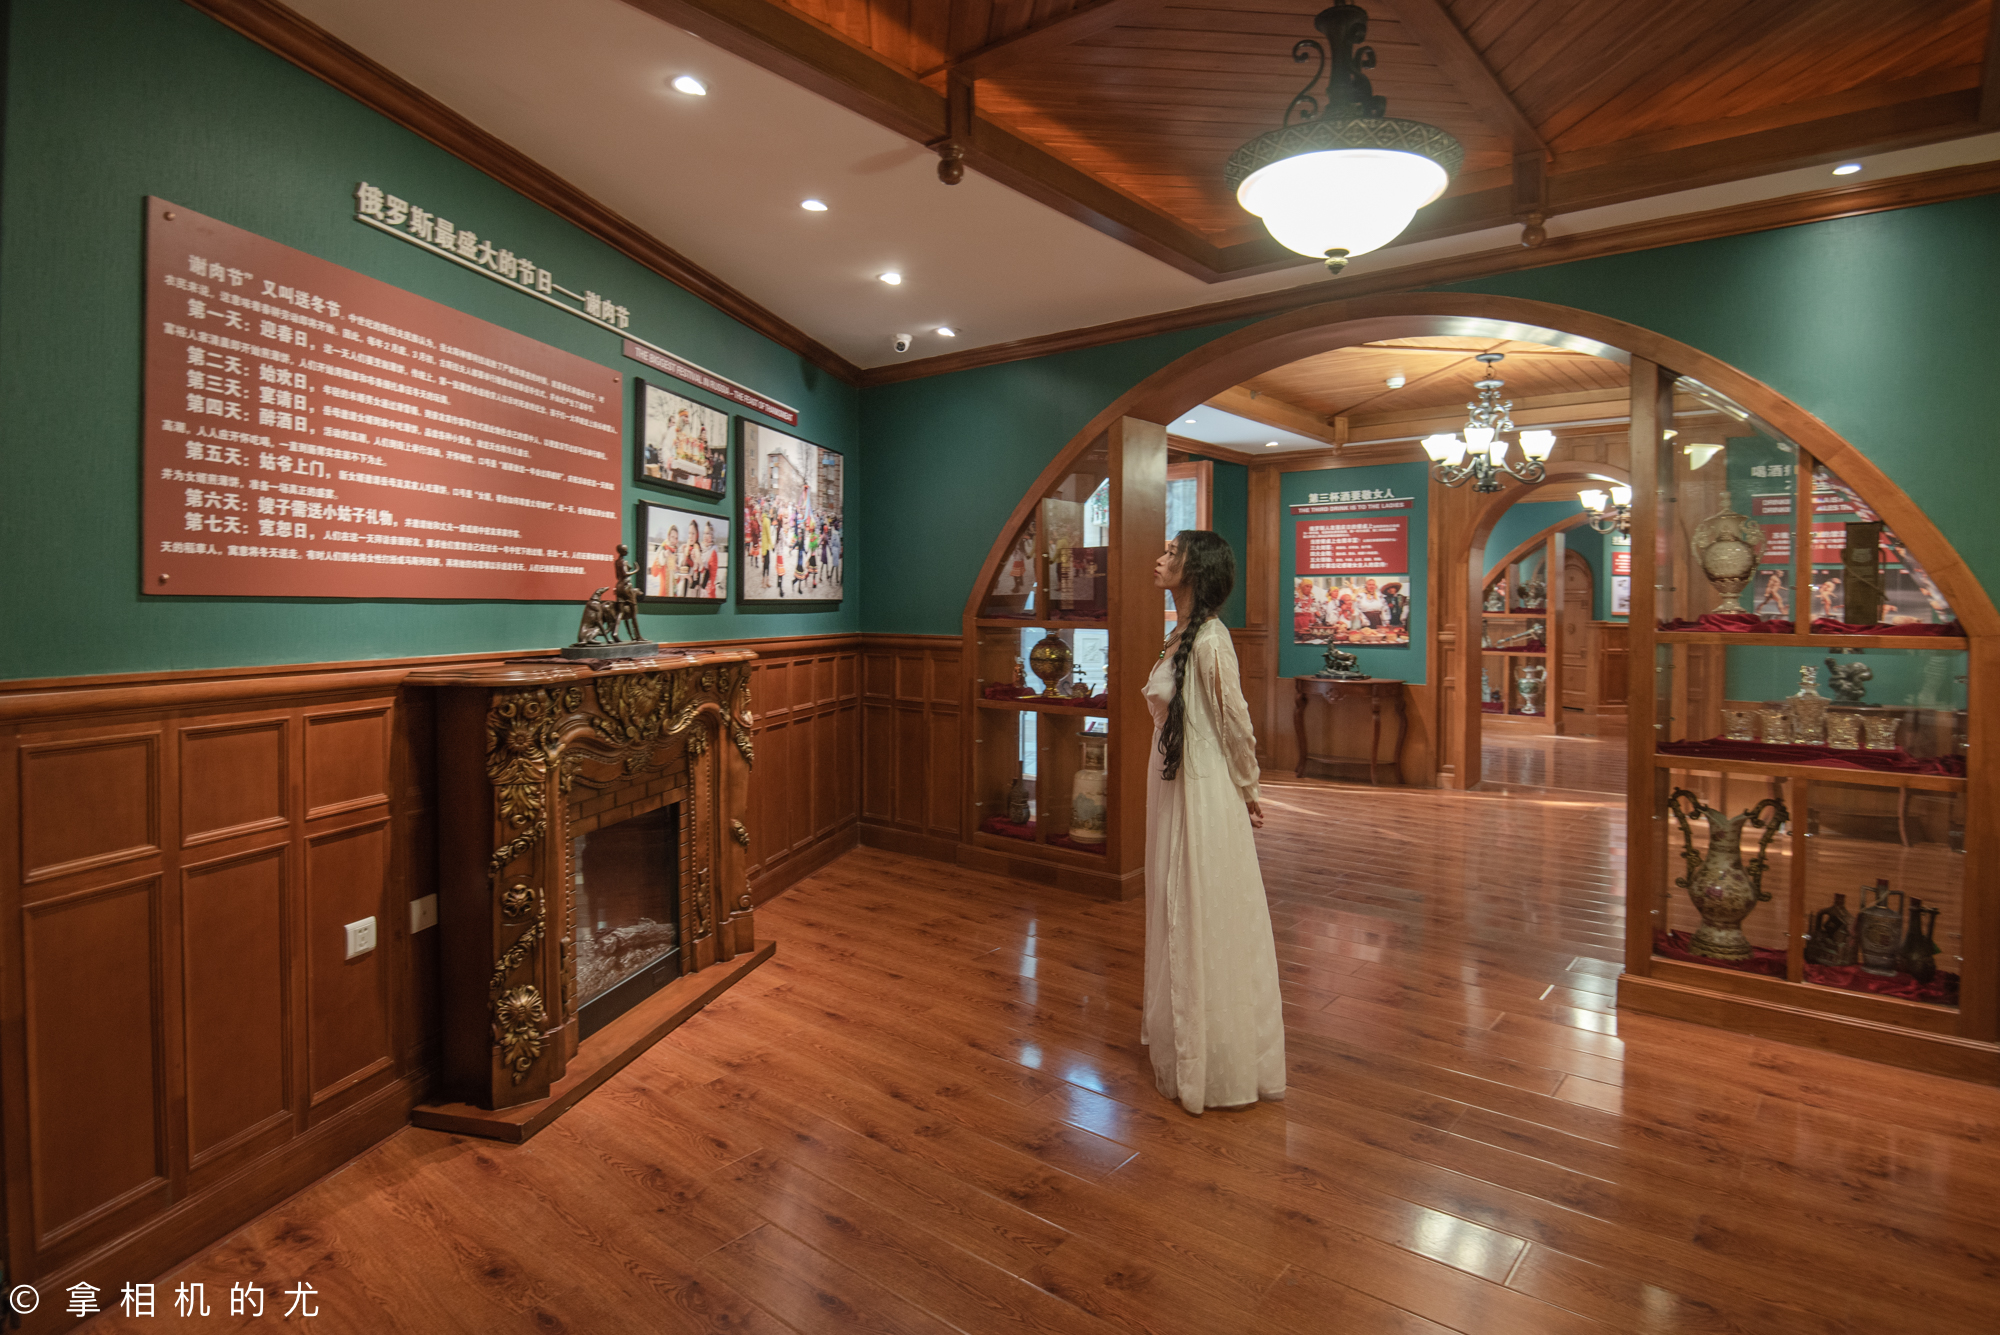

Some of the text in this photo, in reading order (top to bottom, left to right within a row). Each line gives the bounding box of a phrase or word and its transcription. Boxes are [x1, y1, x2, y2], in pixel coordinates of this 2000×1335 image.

[635, 347, 649, 361] THE
[1308, 488, 1395, 504] 第三杯酒要敬女人
